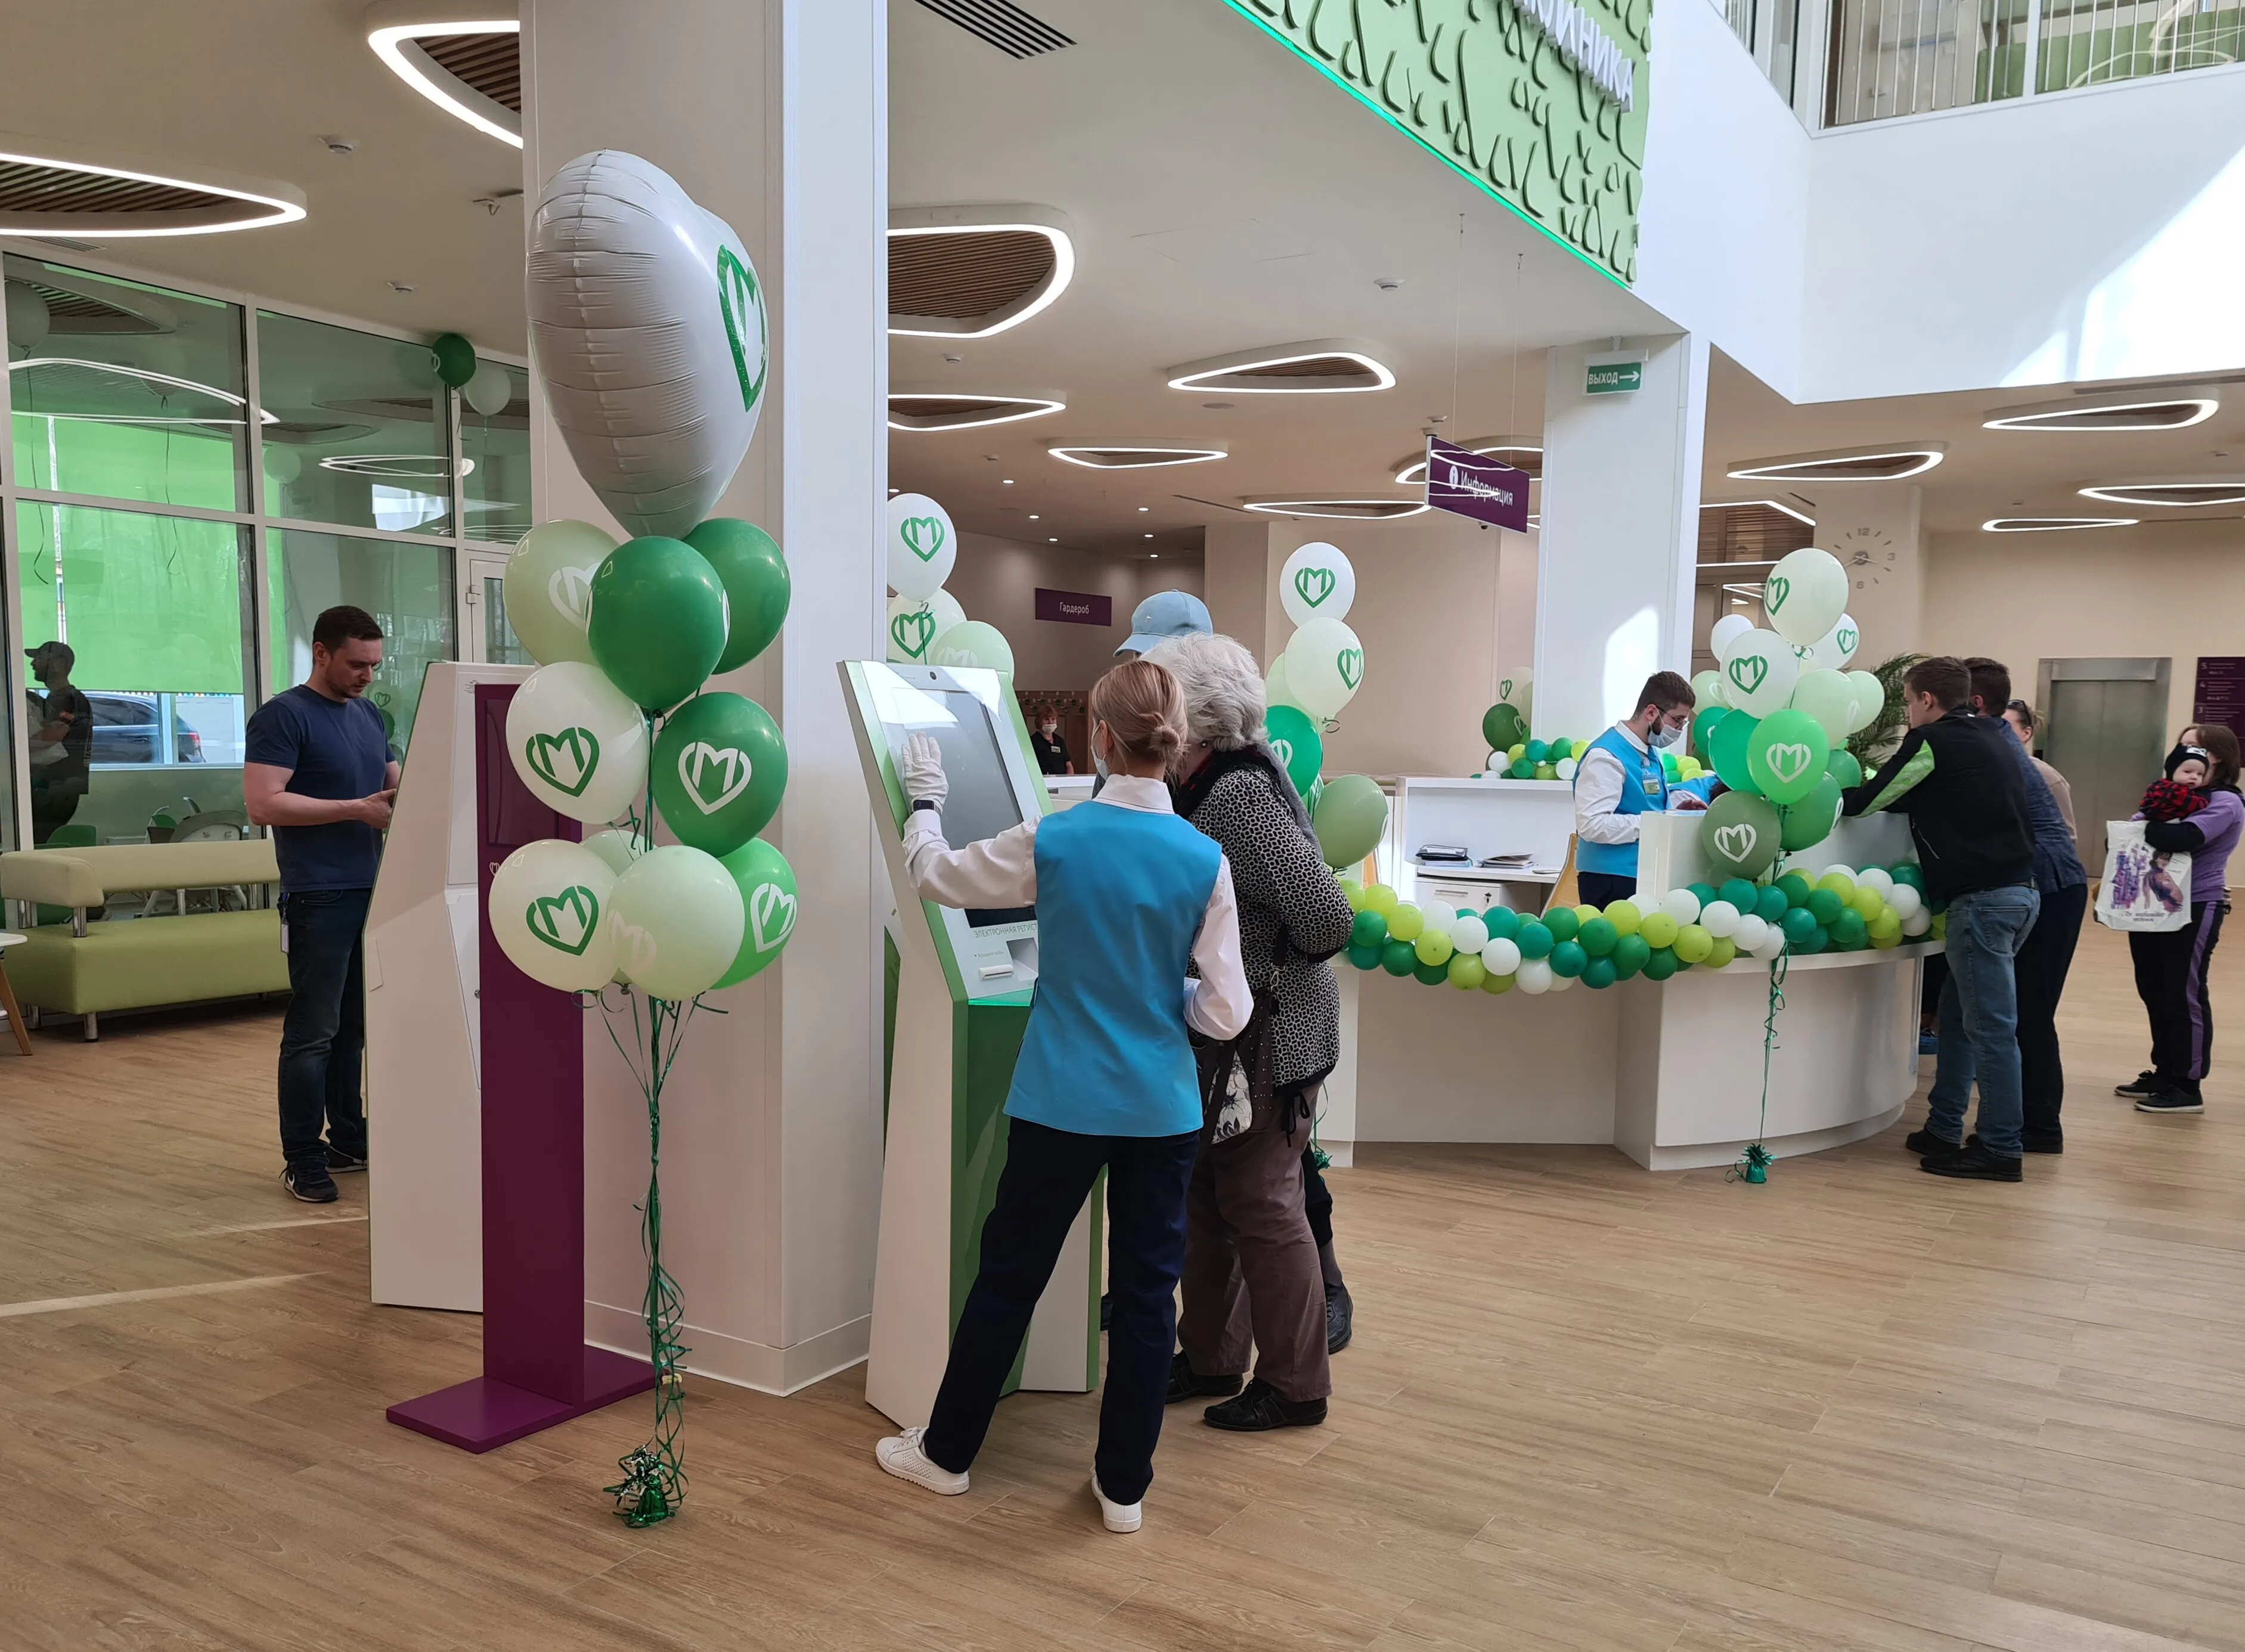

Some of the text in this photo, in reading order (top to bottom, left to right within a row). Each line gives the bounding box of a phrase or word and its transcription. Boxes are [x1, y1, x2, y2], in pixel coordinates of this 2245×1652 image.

[1588, 372, 1618, 385] ВЫХОД
[1858, 528, 1869, 536] 12
[1887, 553, 1896, 561] 3
[1856, 581, 1865, 589] 6
[1059, 602, 1090, 615] Гардероб
[973, 926, 1016, 938] ЭЛЕКТРОННАЯ
